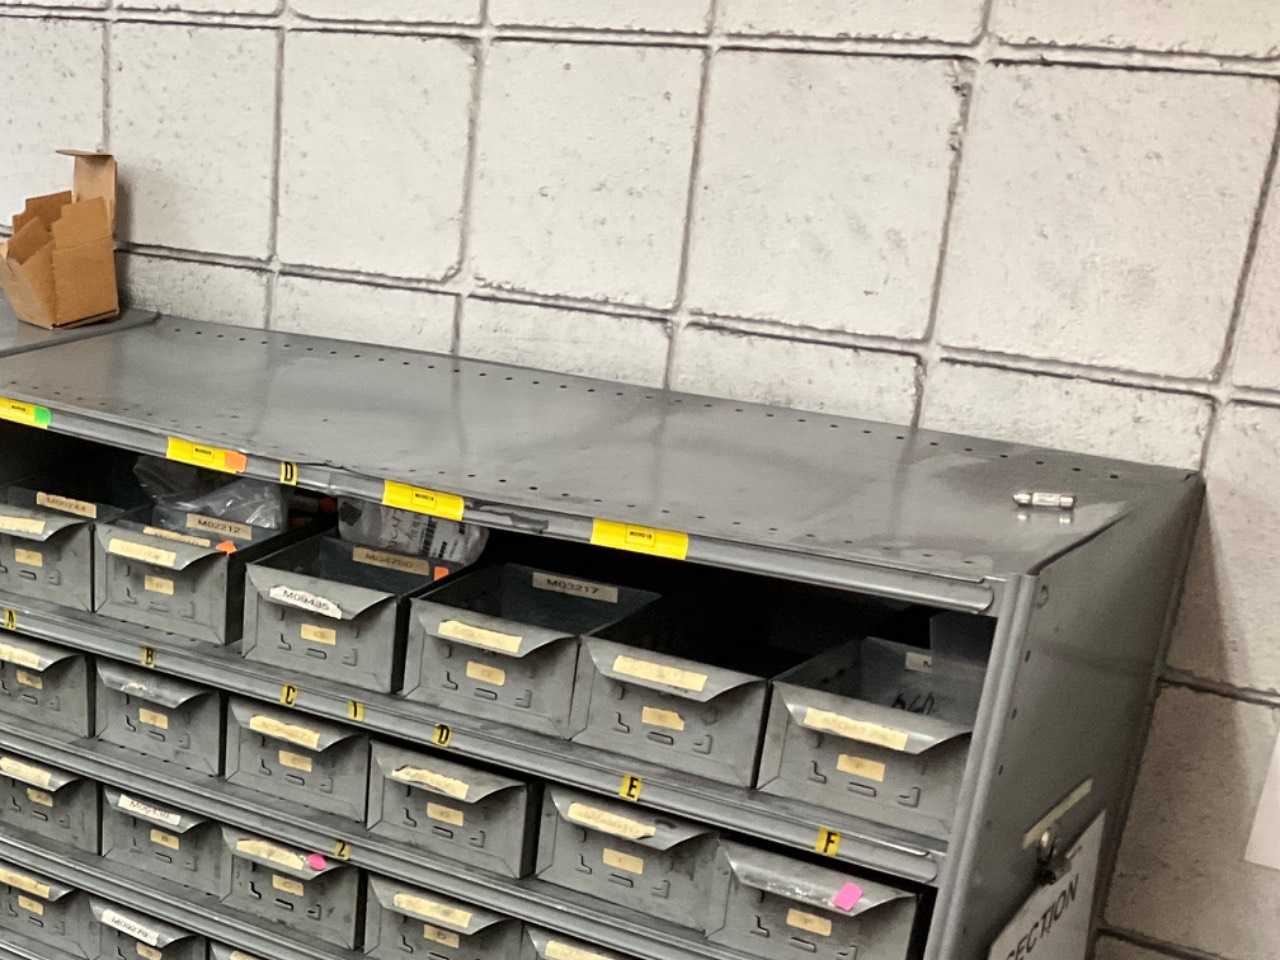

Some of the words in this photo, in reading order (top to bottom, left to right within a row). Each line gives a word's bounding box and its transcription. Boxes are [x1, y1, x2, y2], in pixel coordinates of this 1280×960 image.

[283, 461, 293, 481] D
[145, 647, 154, 665] B
[285, 685, 296, 705] C
[438, 725, 450, 744] D
[626, 777, 640, 800] E
[336, 839, 346, 857] 2
[824, 832, 837, 854] F
